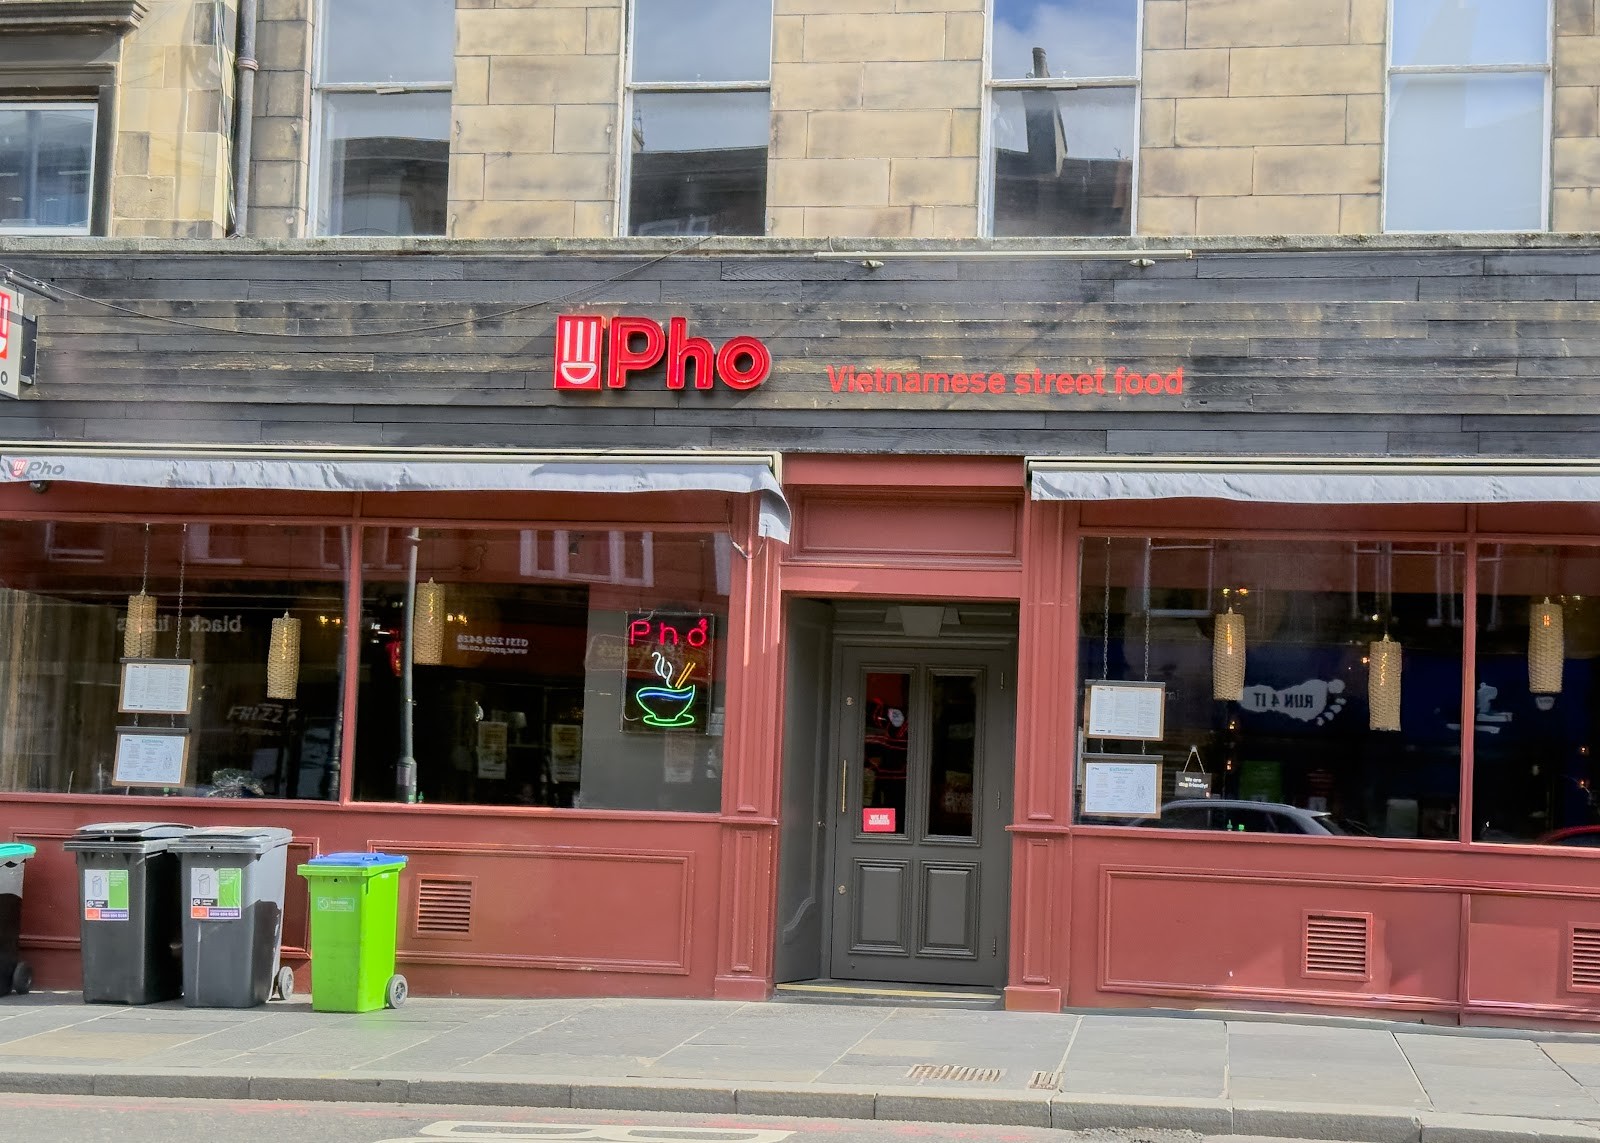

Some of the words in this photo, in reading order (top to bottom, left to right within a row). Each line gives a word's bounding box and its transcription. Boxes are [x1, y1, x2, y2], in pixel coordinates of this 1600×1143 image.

[607, 316, 772, 390] Pho
[825, 365, 1006, 394] Vietnamese
[1014, 367, 1105, 395] street
[1113, 366, 1185, 395] food
[25, 461, 65, 476] Pho
